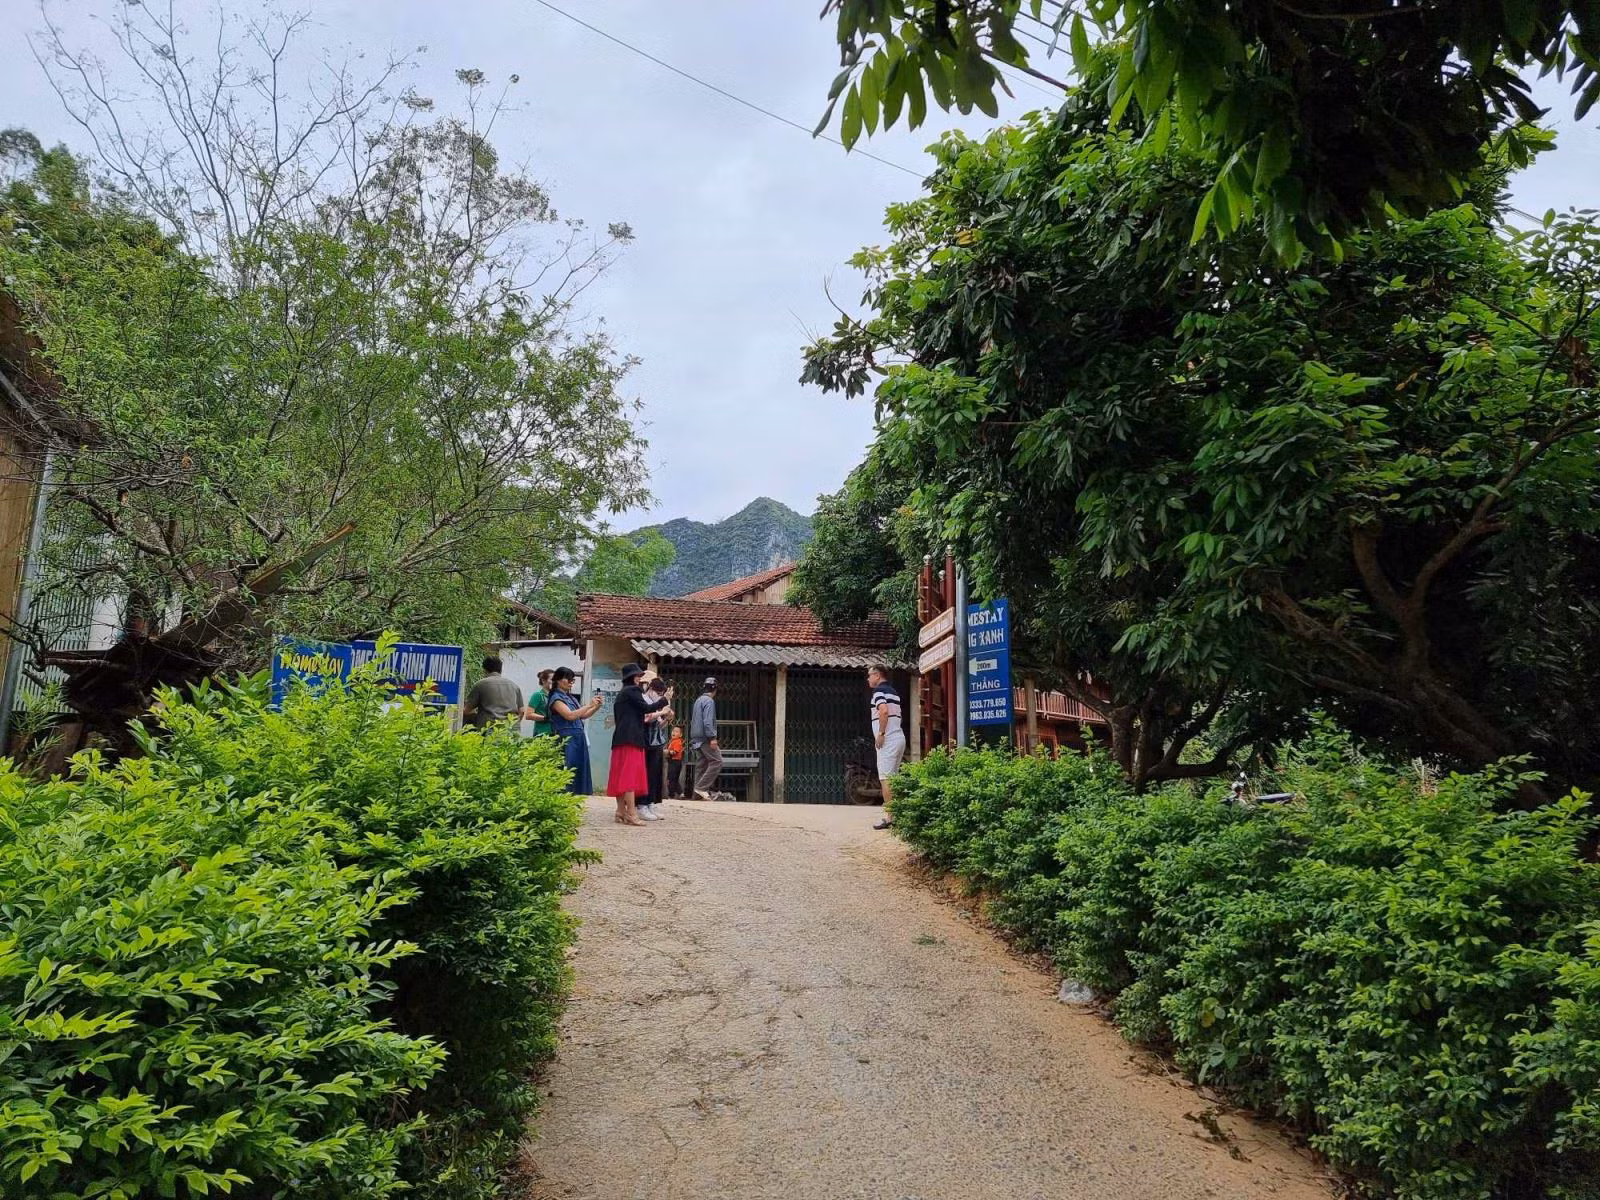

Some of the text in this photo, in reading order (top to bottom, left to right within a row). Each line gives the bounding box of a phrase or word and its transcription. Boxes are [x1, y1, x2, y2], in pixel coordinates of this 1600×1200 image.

[968, 607, 1004, 626] MESTAY
[979, 628, 1004, 646] XANH
[428, 654, 458, 682] MINH
